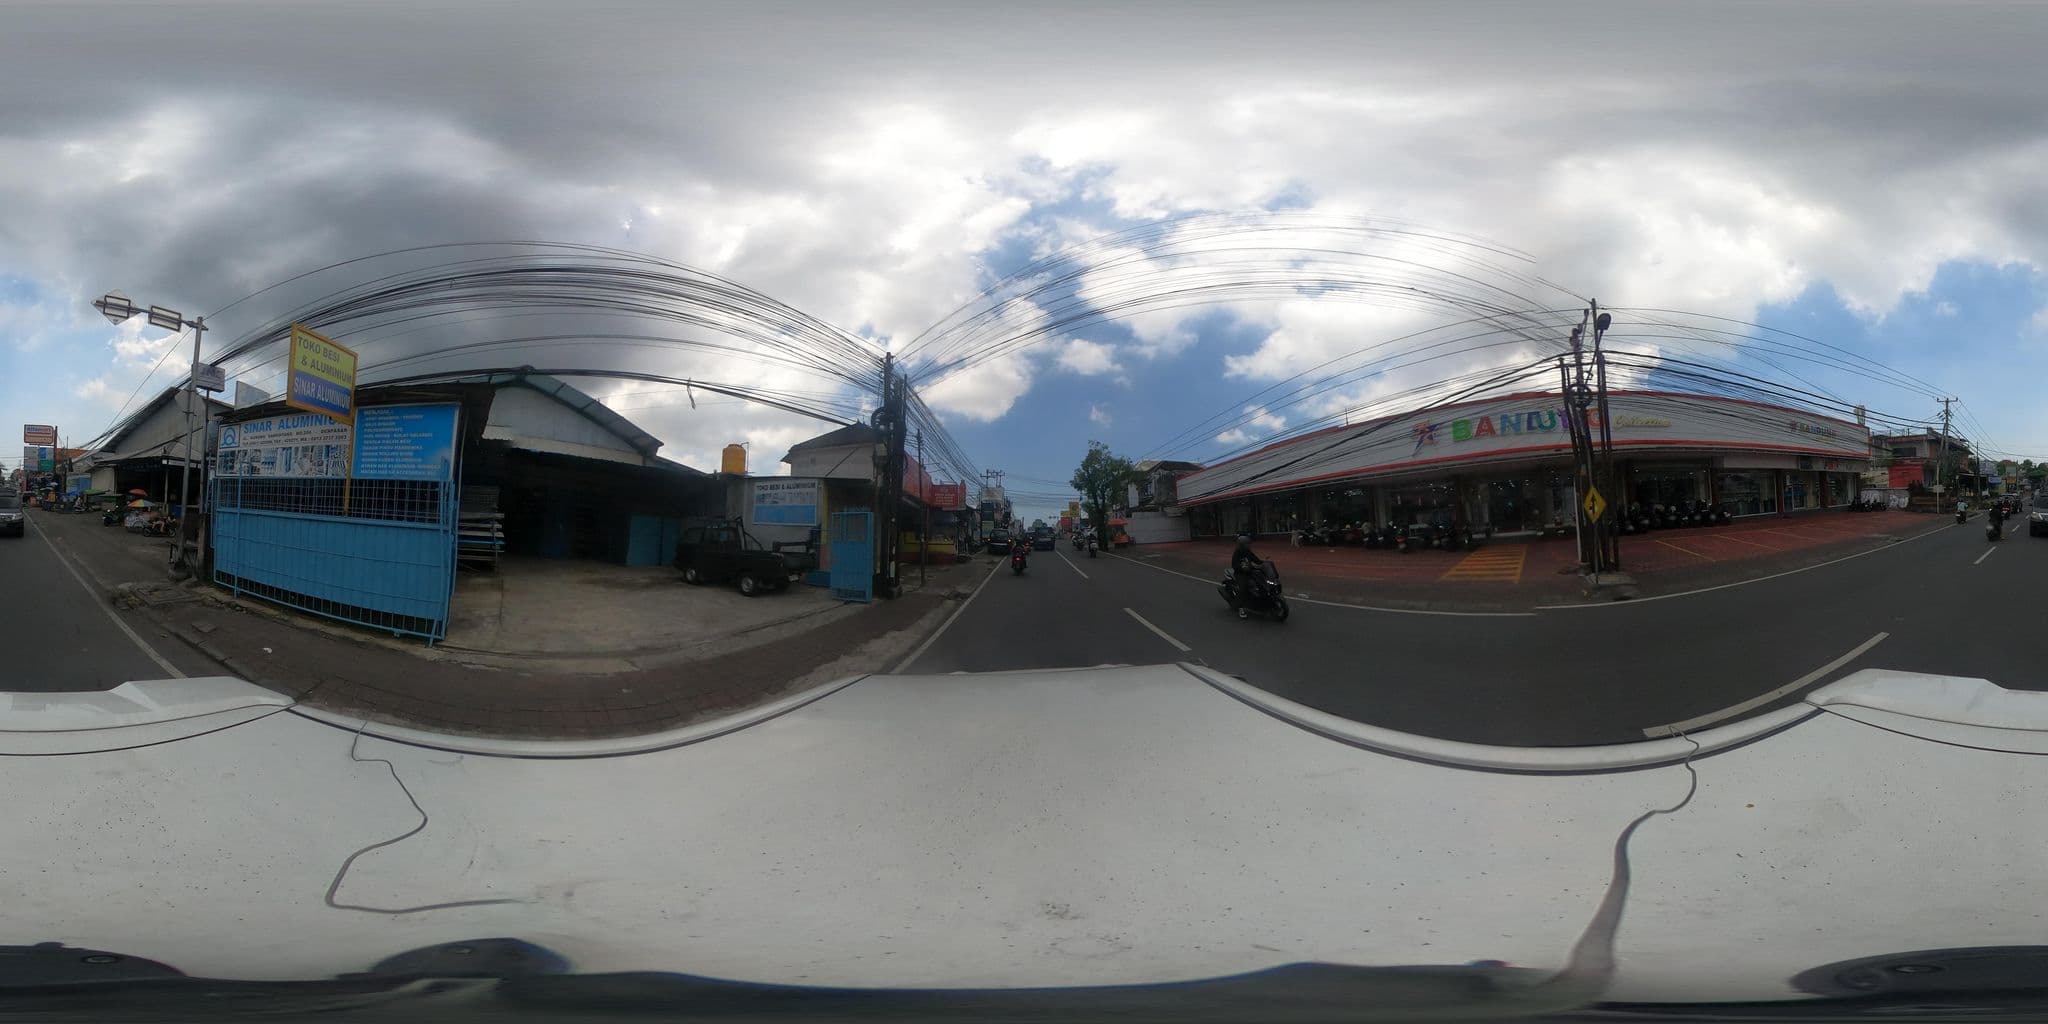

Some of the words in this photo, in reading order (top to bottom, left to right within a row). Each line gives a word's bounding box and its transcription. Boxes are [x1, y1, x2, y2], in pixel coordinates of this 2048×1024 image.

[298, 336, 320, 354] TOKO
[322, 347, 340, 364] BESI
[301, 354, 308, 366] &
[310, 358, 352, 383] ALUMINIUM
[294, 376, 316, 399] SINAR
[315, 385, 351, 409] ALUMINIUM
[243, 420, 272, 434] SINAR
